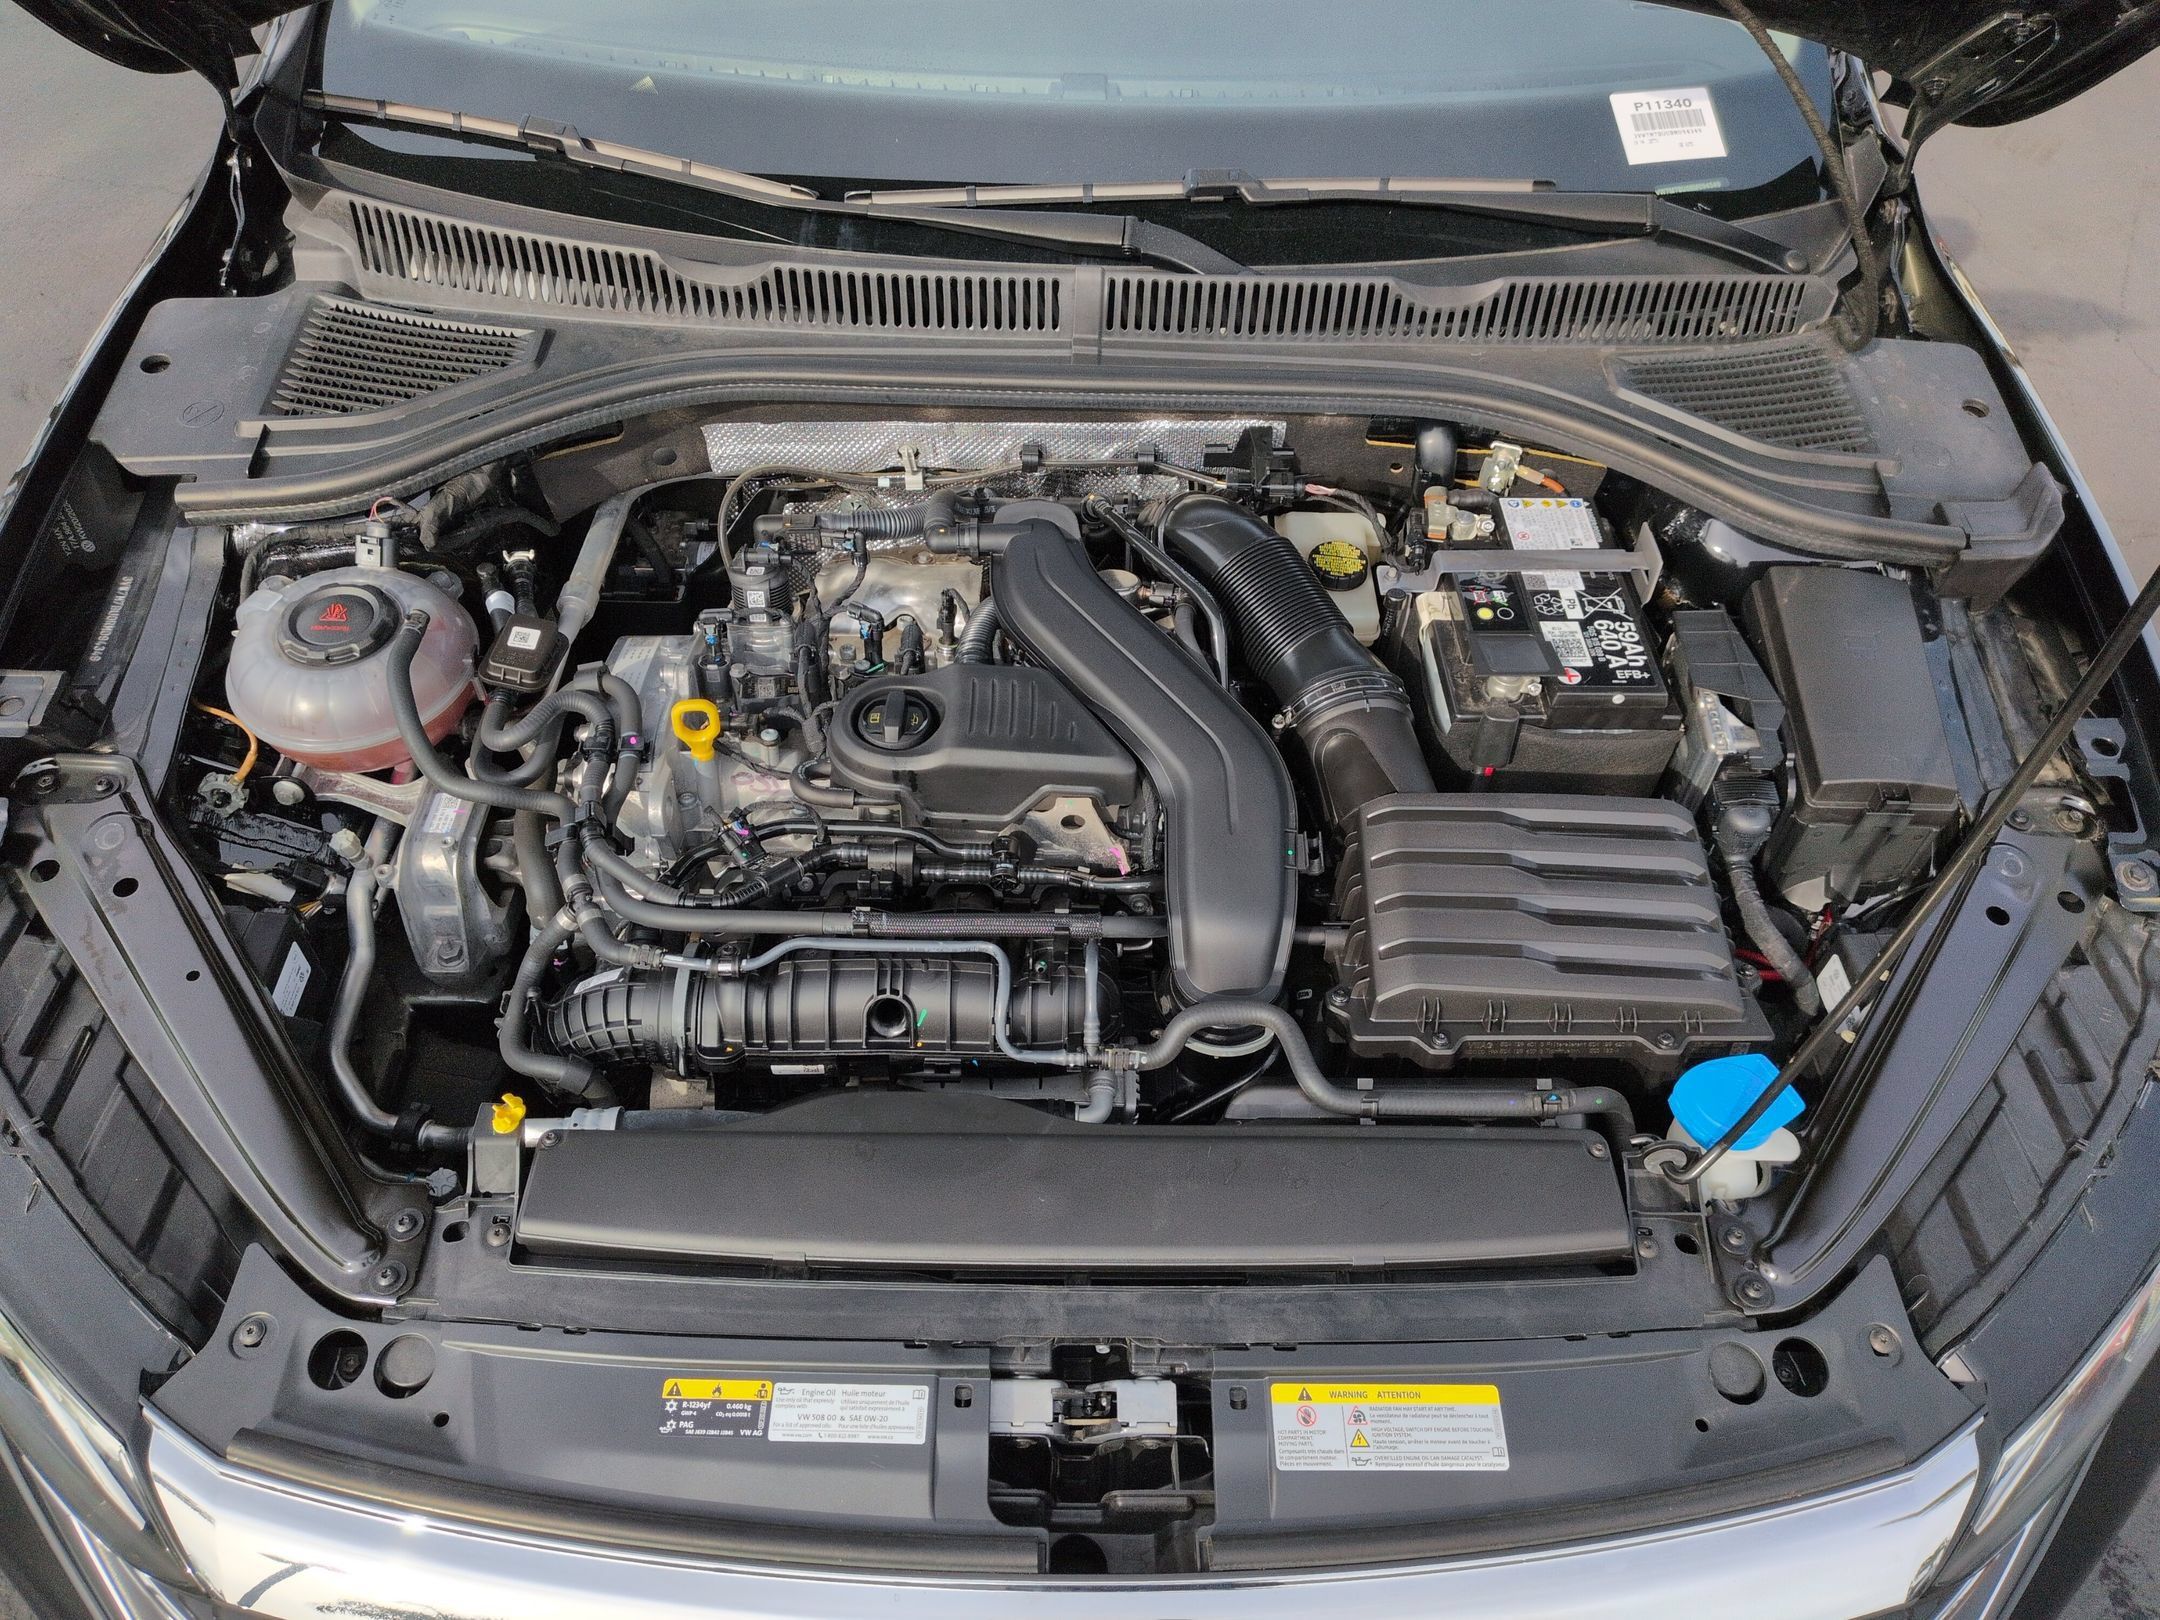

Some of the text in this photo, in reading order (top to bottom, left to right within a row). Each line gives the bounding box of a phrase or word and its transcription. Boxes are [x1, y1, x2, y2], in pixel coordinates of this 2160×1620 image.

[1633, 98, 1693, 112] P11340
[1567, 598, 1576, 610] Pb
[1593, 619, 1629, 669] 640 A
[1614, 621, 1648, 667] 59Ah
[1615, 669, 1651, 679] EFB+
[802, 1388, 836, 1398] Engine Oil
[842, 1390, 860, 1398] Huile
[1328, 1391, 1421, 1400] WARNING ATTENTION
[682, 1400, 712, 1411] R-1234yf
[726, 1403, 752, 1411] 0.460 kg
[798, 1413, 889, 1422] VW 508 00 & SAE 0W-20
[679, 1420, 695, 1428] PAG
[740, 1429, 763, 1437] VW AG
